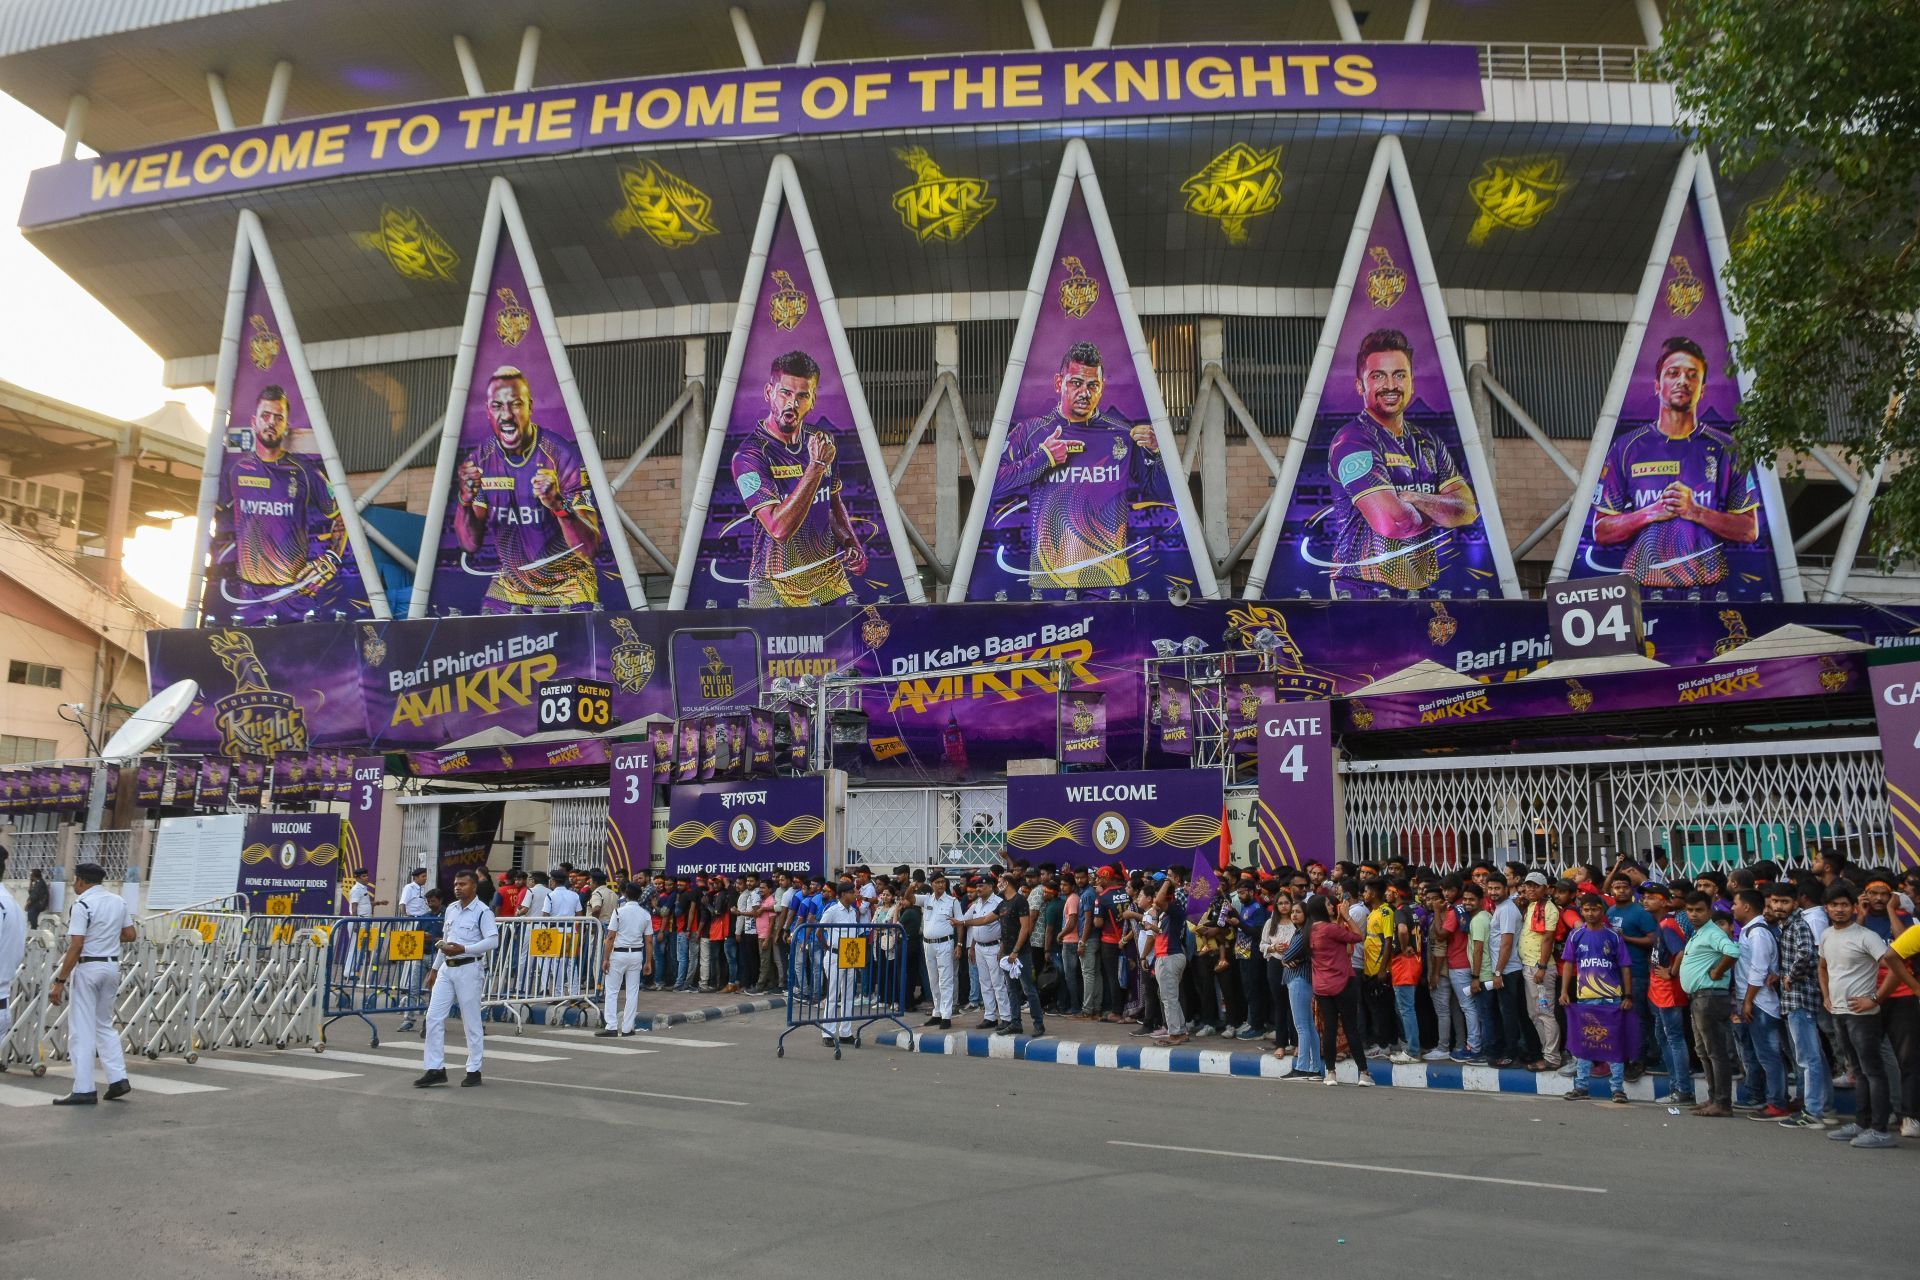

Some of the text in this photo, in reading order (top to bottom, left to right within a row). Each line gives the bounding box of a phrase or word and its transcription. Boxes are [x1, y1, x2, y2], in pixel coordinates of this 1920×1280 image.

[90, 54, 1378, 201] WELCOME TO THE HOME OF THE KNIGHTS
[897, 181, 985, 228] KKR
[1555, 585, 1627, 605] GATE NO
[1561, 604, 1632, 647] 04
[767, 635, 824, 654] EKDUM
[892, 616, 1094, 676] Dil Kahe Baar Baar
[389, 631, 559, 692] Bari Phirchi Ebar
[1456, 643, 1506, 674] Bari
[700, 675, 732, 685] KNIGHT
[888, 639, 1100, 713] AMI KKR
[1678, 665, 1759, 691] Dil Kahe Baar Baar
[1678, 672, 1764, 703] AMI KKR
[391, 653, 558, 728] AMI KKR
[540, 684, 573, 697] GATE NO
[577, 685, 610, 698] GATE NO
[703, 685, 732, 698] CLUB
[1419, 688, 1486, 712] Bari Phirchi Ebar
[541, 697, 571, 724] 03
[578, 697, 609, 725] 03
[1420, 695, 1492, 723] AMI KKR
[1265, 717, 1322, 738] GATE
[355, 767, 380, 781] GATE
[614, 755, 648, 771] GATE
[1280, 745, 1309, 782] 4
[360, 785, 373, 812] 3
[624, 775, 640, 804] 3
[720, 791, 768, 809] স্বাগতম
[1066, 784, 1157, 803] WELCOME
[271, 822, 312, 834] WELCOME
[706, 863, 717, 873] OF
[719, 862, 736, 873] THE
[739, 862, 772, 873] KNIGHT
[245, 878, 327, 888] HOME OF THE KNIGHT RIDERS
